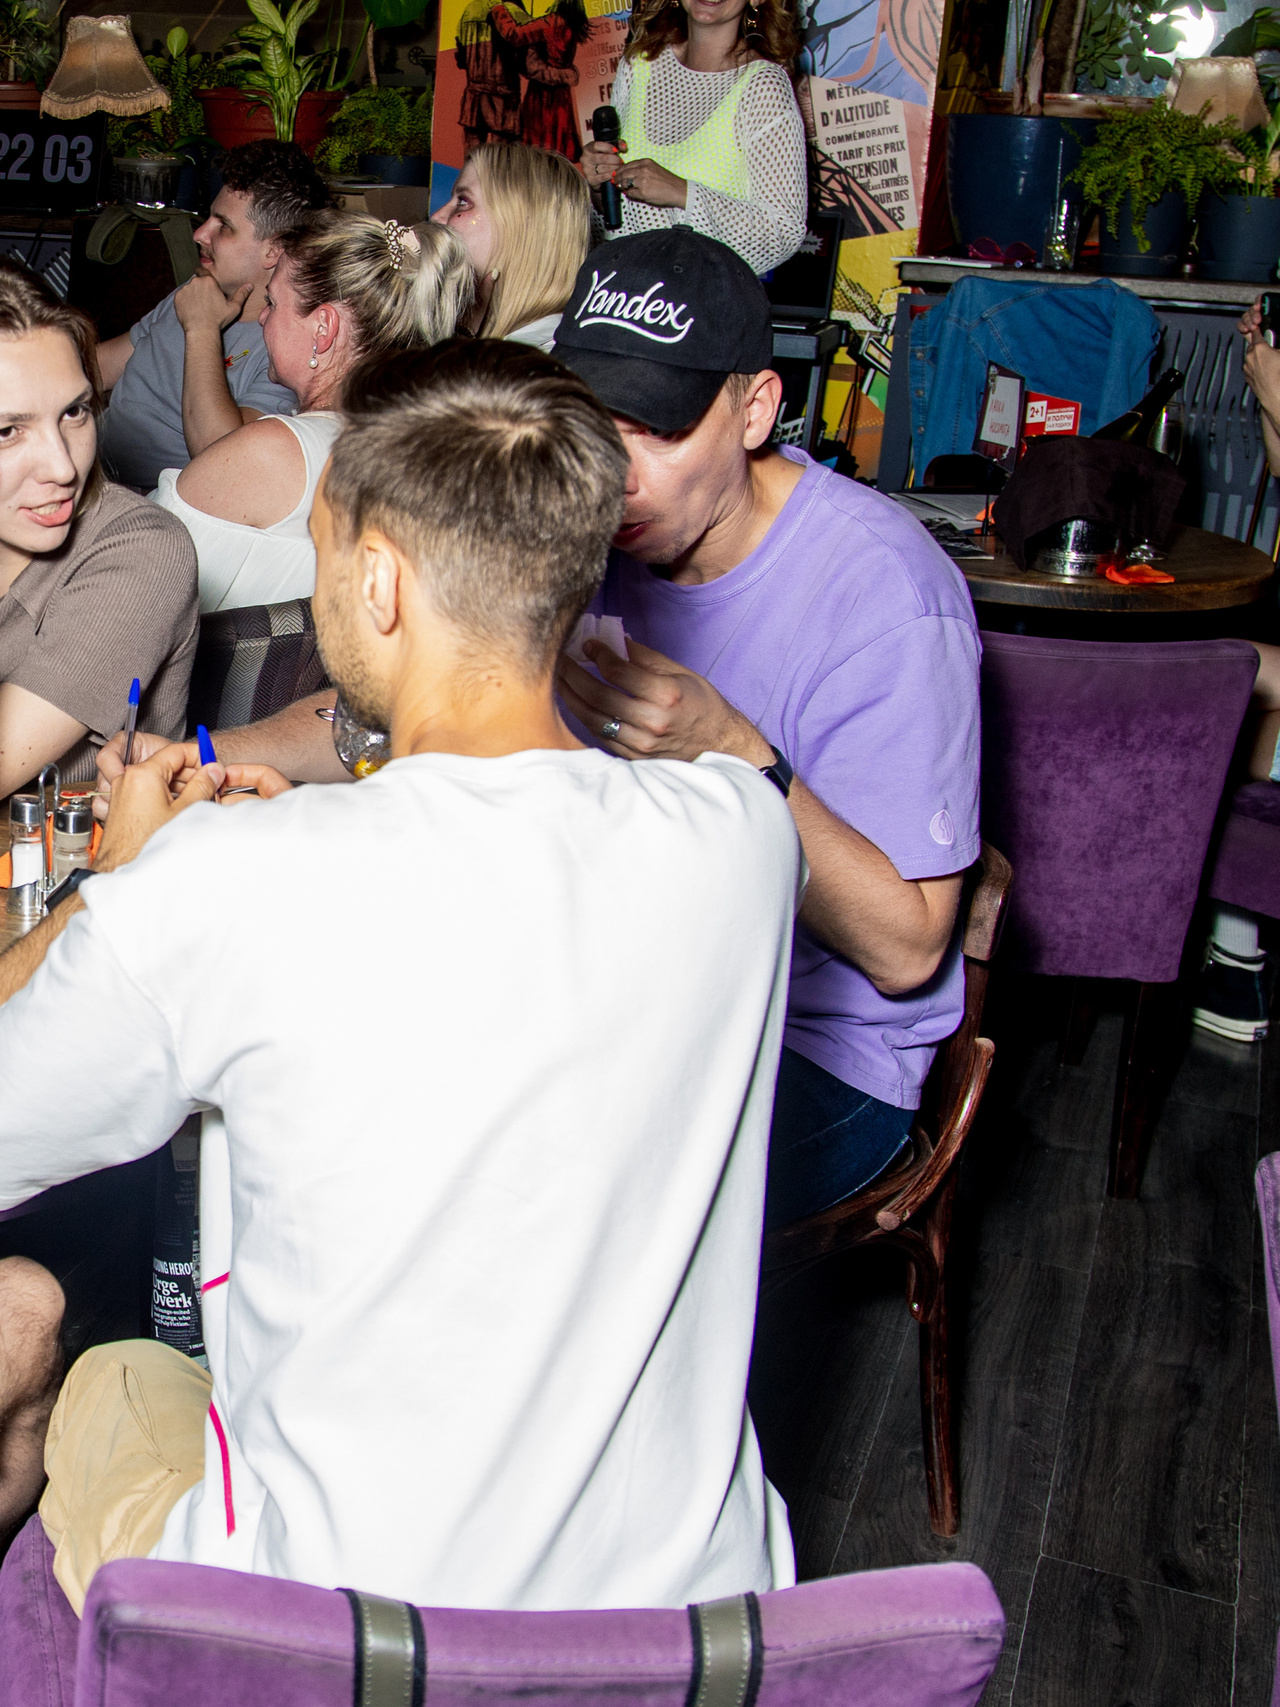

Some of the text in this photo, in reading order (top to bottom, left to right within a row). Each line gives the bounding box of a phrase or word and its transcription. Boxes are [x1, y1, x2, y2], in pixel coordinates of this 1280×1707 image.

[820, 99, 891, 127] D'ALTITUDE
[825, 124, 900, 146] COMMÉMORATIVE
[42, 134, 93, 184] 03
[837, 147, 864, 162] TARIF
[866, 144, 883, 157] DES
[883, 140, 907, 154] PRIX
[844, 158, 899, 180] SCENSION
[873, 189, 910, 205] OUR DES
[887, 206, 905, 222] ES
[574, 270, 694, 342] Yandex
[1029, 405, 1044, 419] 2+1
[153, 1272, 180, 1296] Urge
